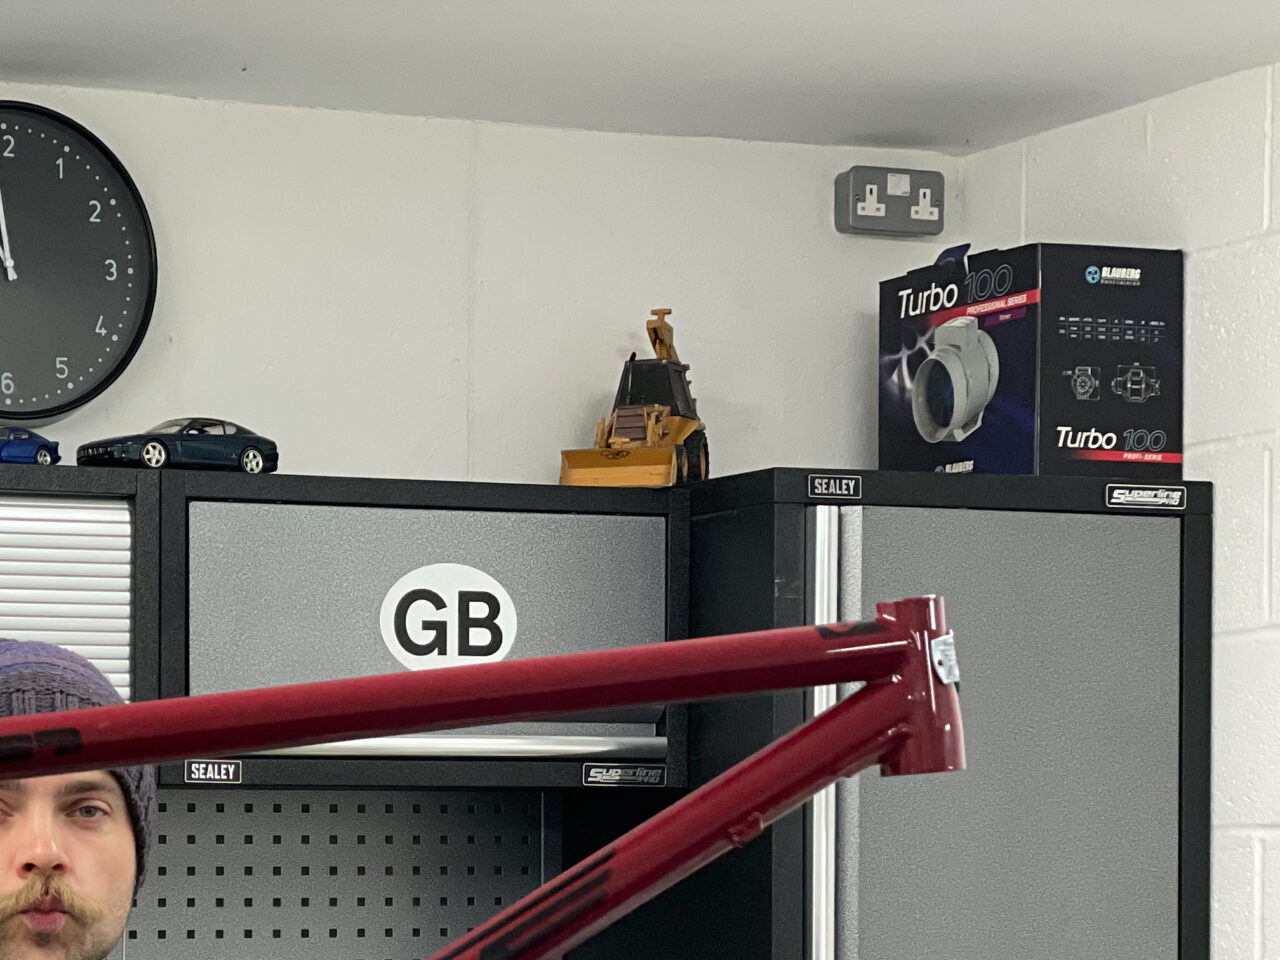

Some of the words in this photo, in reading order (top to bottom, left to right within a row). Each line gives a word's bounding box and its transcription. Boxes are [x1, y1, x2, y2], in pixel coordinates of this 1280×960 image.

[55, 157, 63, 179] 1
[89, 200, 101, 222] 2
[104, 259, 117, 281] 3
[898, 282, 959, 319] Turbo
[964, 264, 1014, 303] 100
[94, 315, 108, 336] 4
[55, 357, 69, 378] 5
[1, 372, 14, 394] 6
[1056, 426, 1117, 449] Turbo
[1122, 428, 1167, 451] 100
[814, 478, 856, 495] SEALEY
[393, 588, 504, 657] GB
[191, 763, 235, 780] SEALEY
